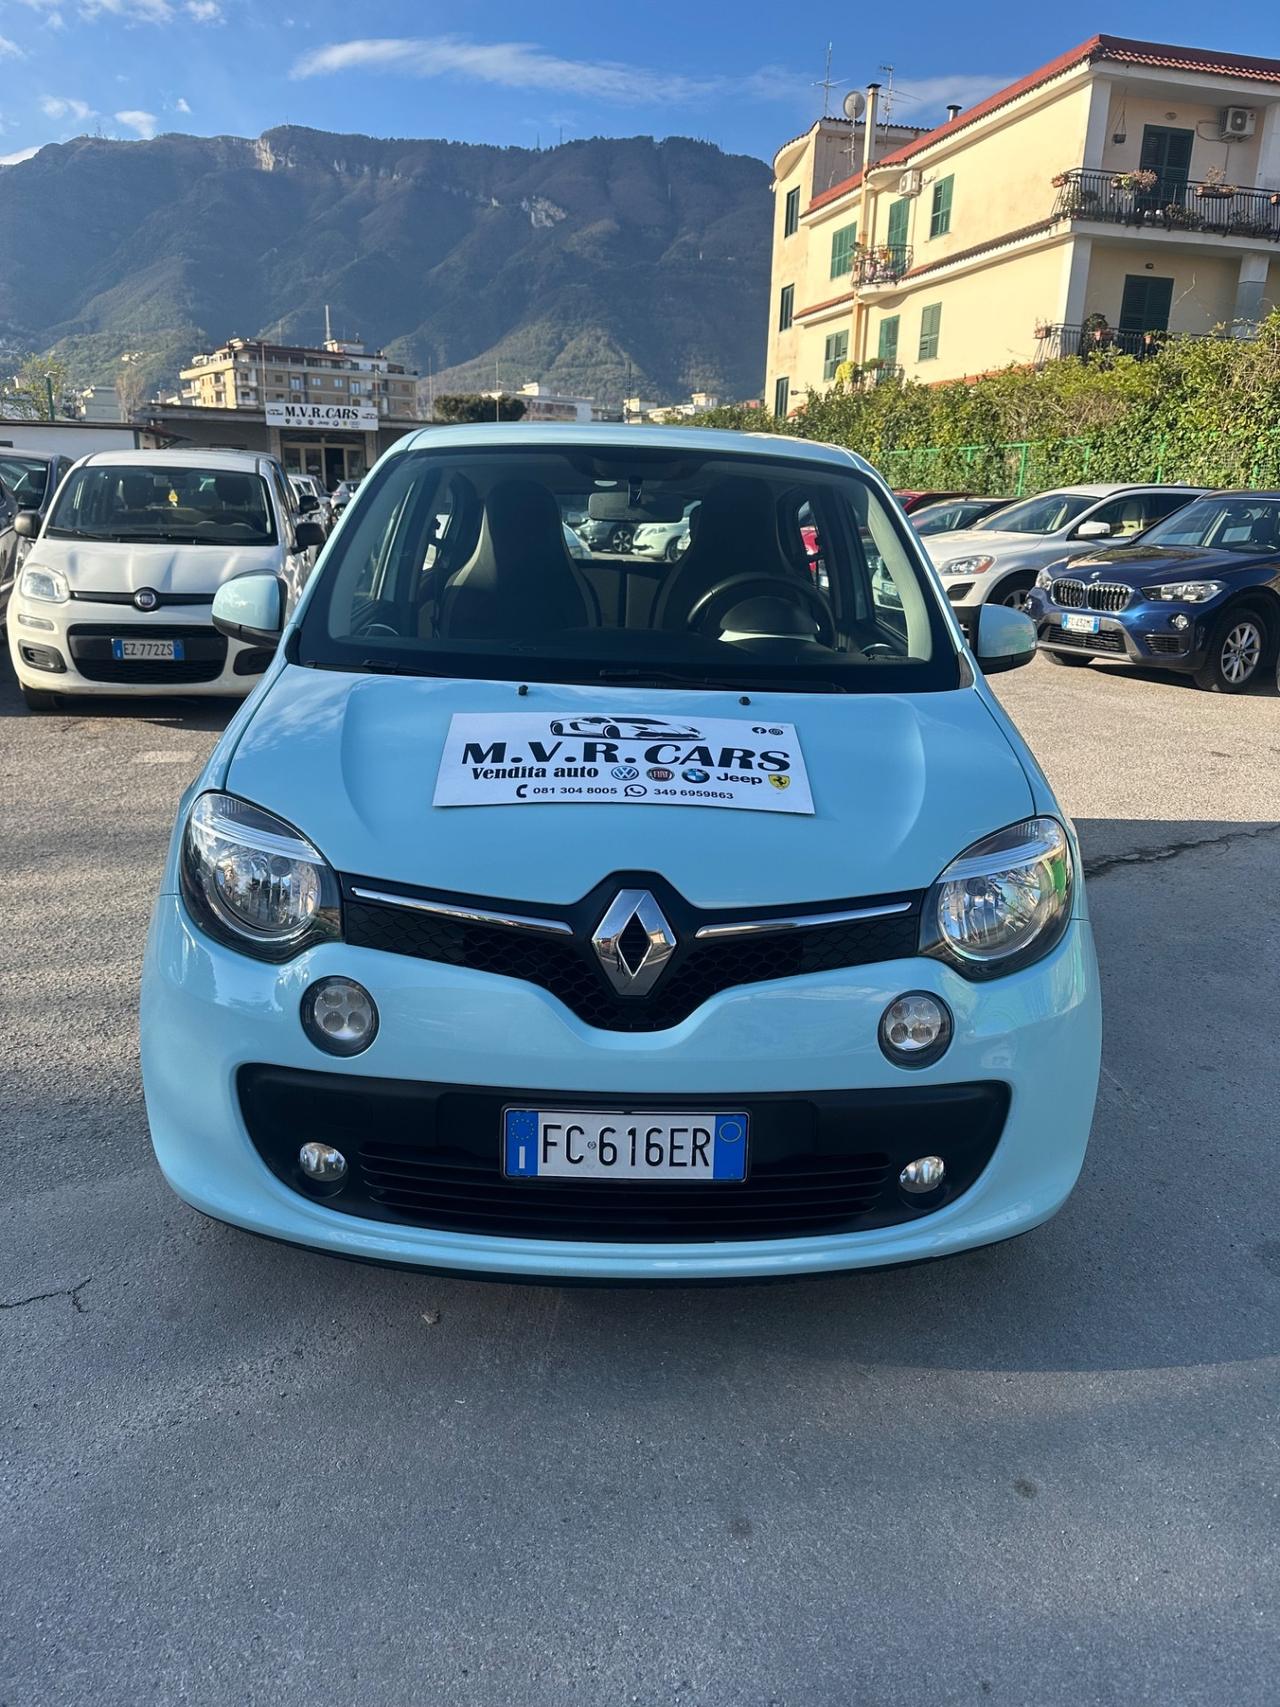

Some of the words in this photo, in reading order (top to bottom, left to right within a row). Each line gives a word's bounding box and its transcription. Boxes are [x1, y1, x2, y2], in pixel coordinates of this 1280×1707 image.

[472, 766, 547, 780] Vendita
[553, 766, 599, 778] auto
[716, 773, 763, 785] Jeep
[653, 788, 677, 796] 349
[680, 789, 734, 799] 6959863
